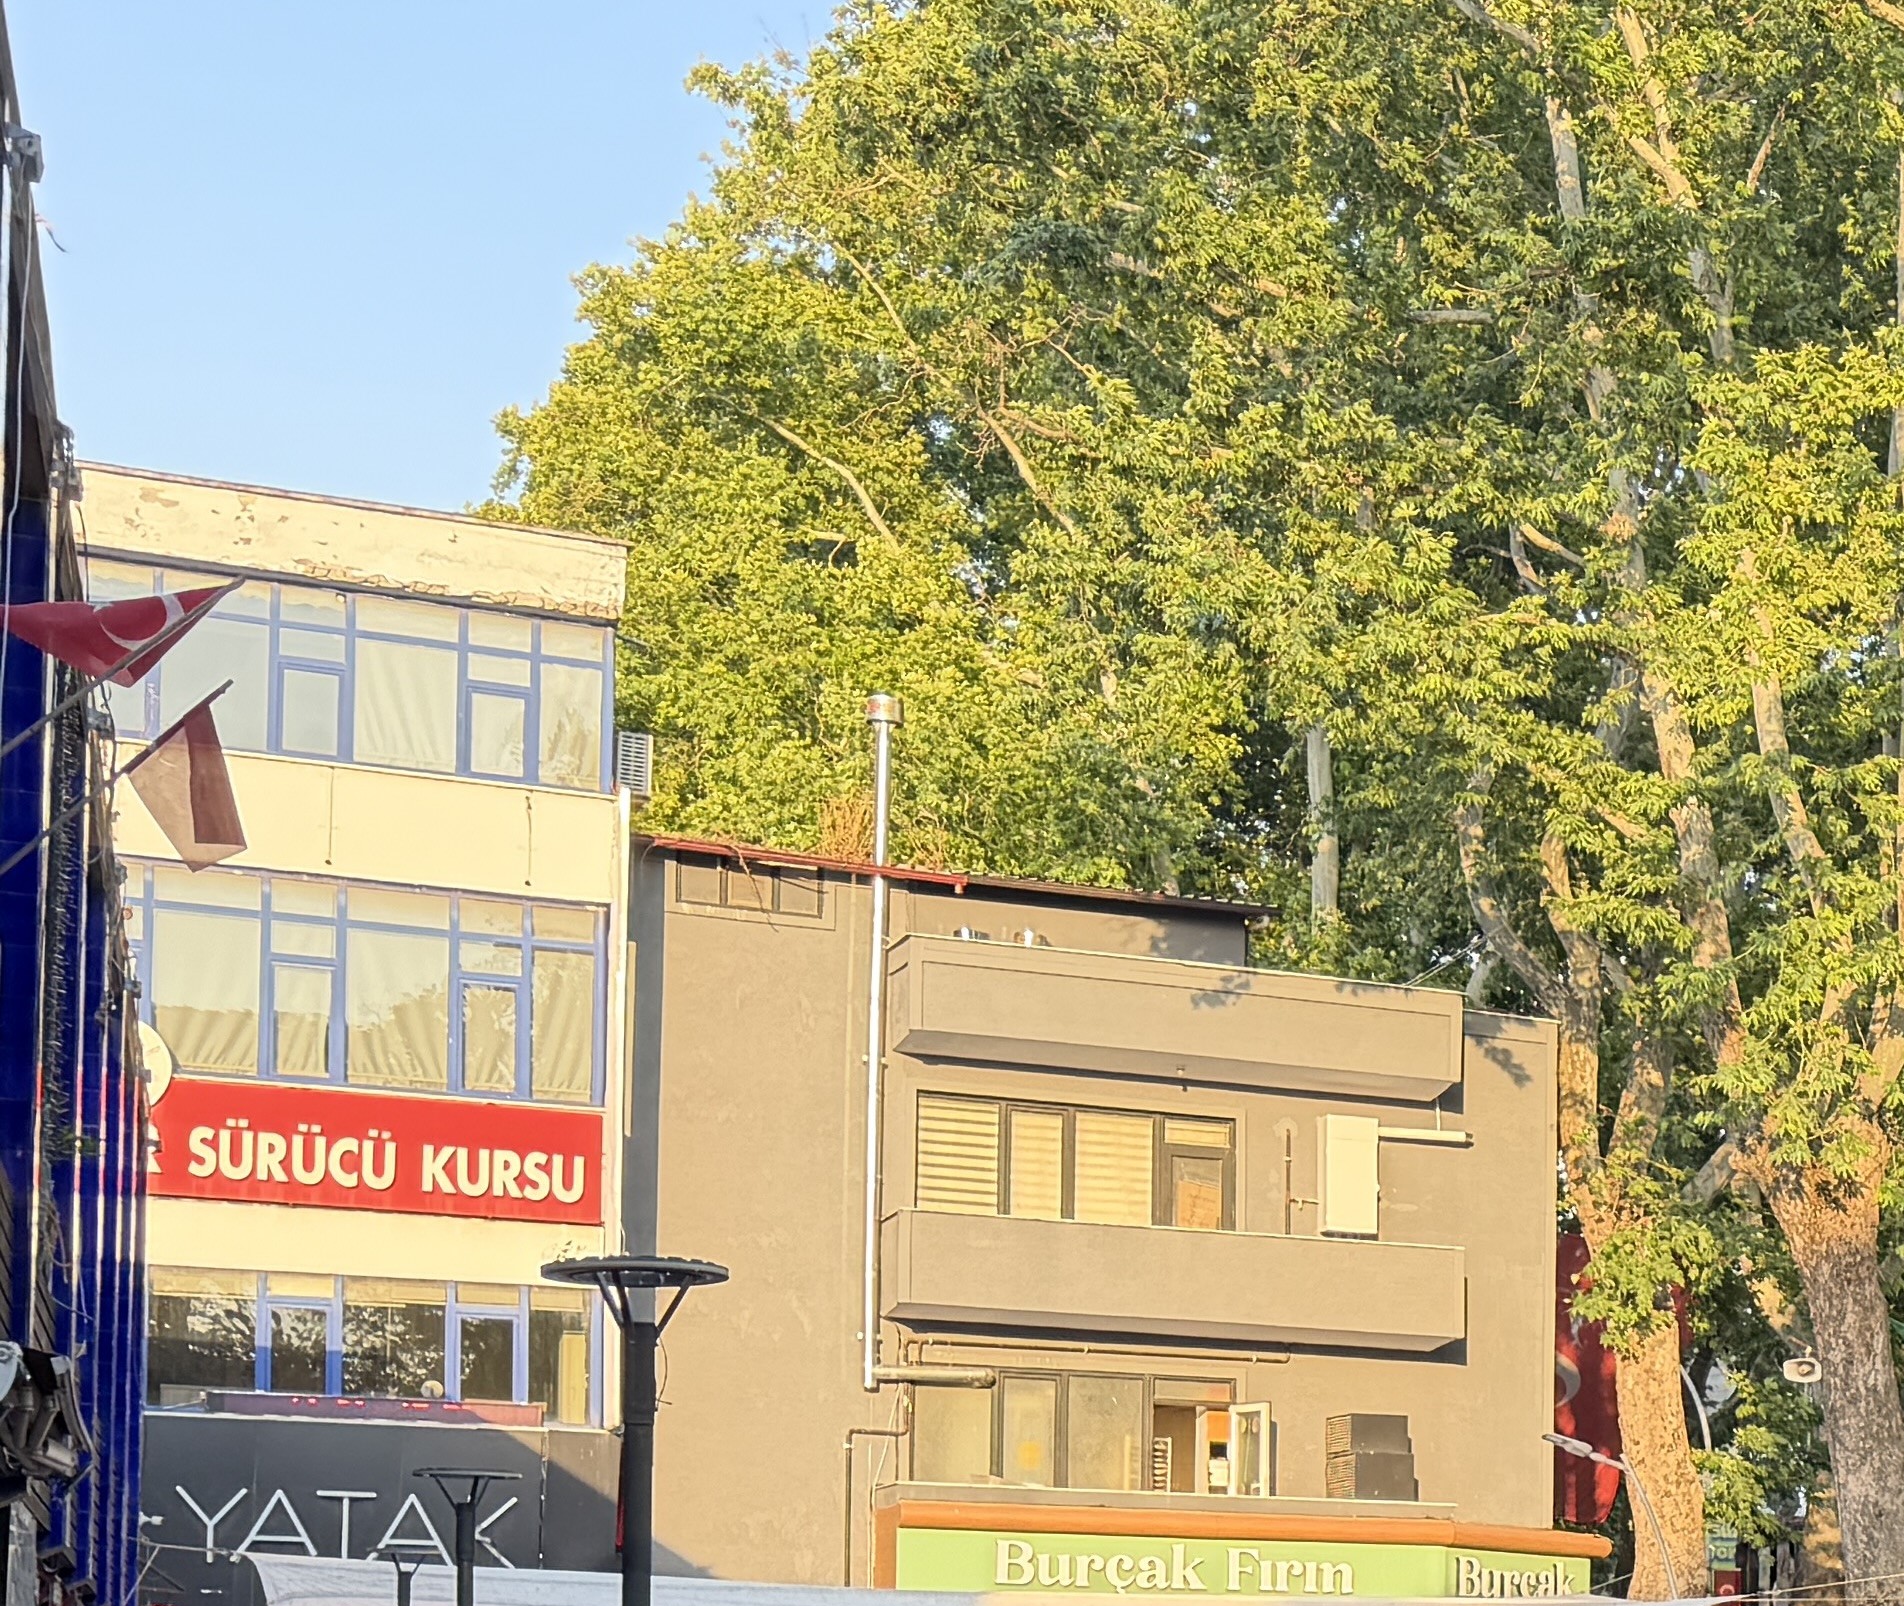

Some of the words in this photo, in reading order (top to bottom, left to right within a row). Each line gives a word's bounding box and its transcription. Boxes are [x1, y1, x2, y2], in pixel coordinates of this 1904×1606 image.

[187, 1117, 398, 1191] SÜRÜCÜ
[420, 1144, 585, 1204] KURSU
[174, 1484, 518, 1569] YATAK
[995, 1539, 1208, 1595] Burçak
[1226, 1547, 1355, 1595] Fırın
